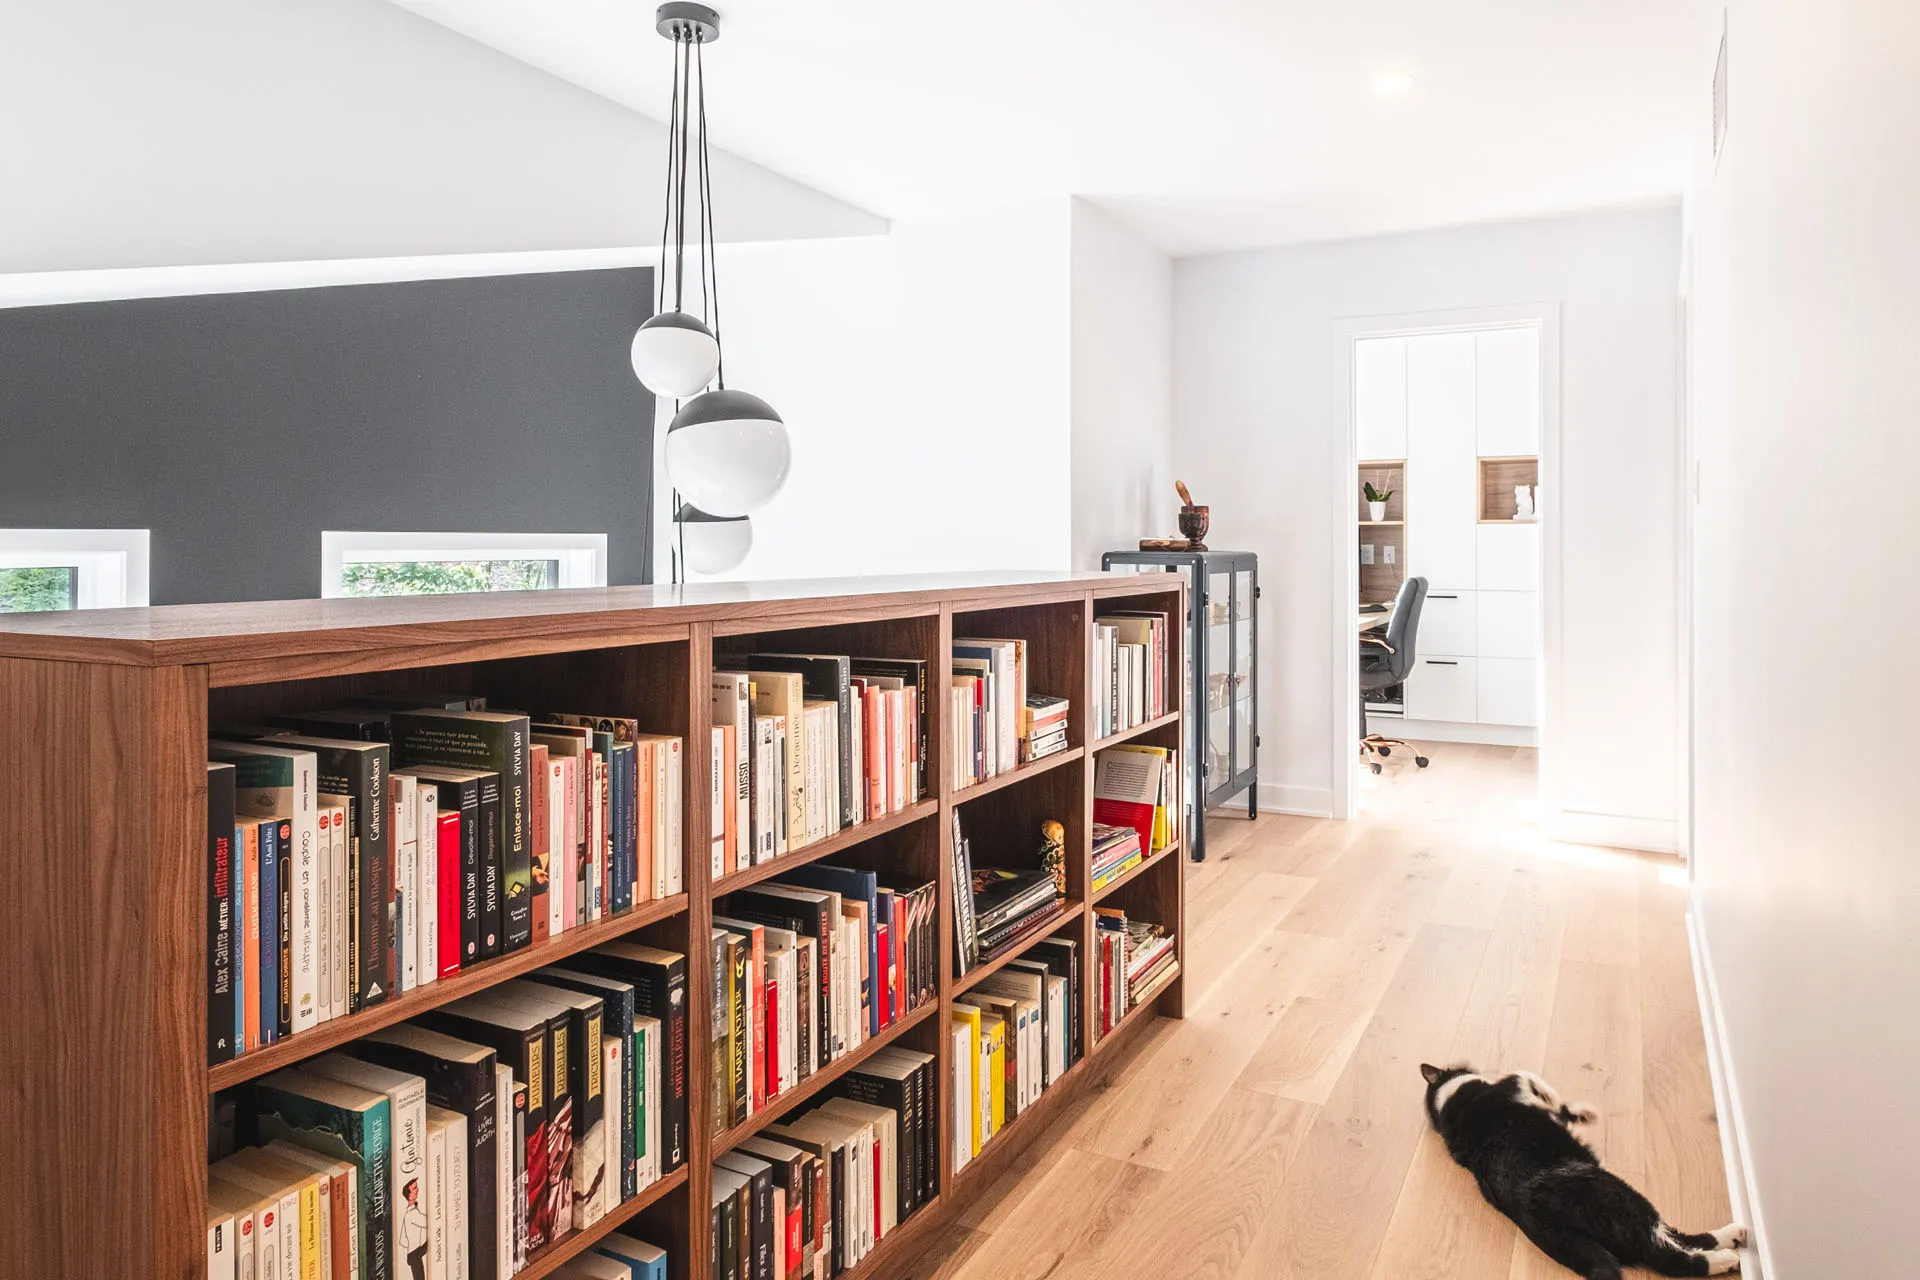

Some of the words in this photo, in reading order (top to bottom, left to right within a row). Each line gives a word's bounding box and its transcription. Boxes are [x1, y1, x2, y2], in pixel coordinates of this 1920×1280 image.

[514, 731, 522, 749] DAY
[790, 712, 801, 775] Déracinée
[370, 757, 381, 797] Cookson
[514, 750, 522, 776] SYLVIA
[739, 762, 749, 800] MUSSO
[370, 799, 381, 841] Catherine
[487, 811, 495, 860] Regarde-moi
[513, 785, 522, 852] Enlace-moi
[301, 830, 311, 866] Couple
[213, 837, 228, 897] infiltrateur
[302, 871, 310, 885] en
[467, 872, 476, 888] DAY
[487, 865, 495, 882] DAY
[467, 888, 476, 920] SYLVIA
[487, 881, 496, 912] SYLVIA
[214, 932, 228, 966] Caine
[215, 967, 228, 994] Alex
[735, 988, 743, 1038] POTTER
[556, 1032, 565, 1093] REBELLES
[590, 1022, 599, 1092] TRICHEUSES
[735, 1040, 743, 1083] HARRY
[531, 1045, 541, 1107] RUMEURS
[372, 1116, 383, 1160] GEORGE
[400, 1118, 415, 1154] tonic
[475, 1128, 496, 1147] JUDITH
[399, 1147, 423, 1174] Gin
[373, 1160, 384, 1218] ELIZABETH
[374, 1229, 384, 1266] WOODS
